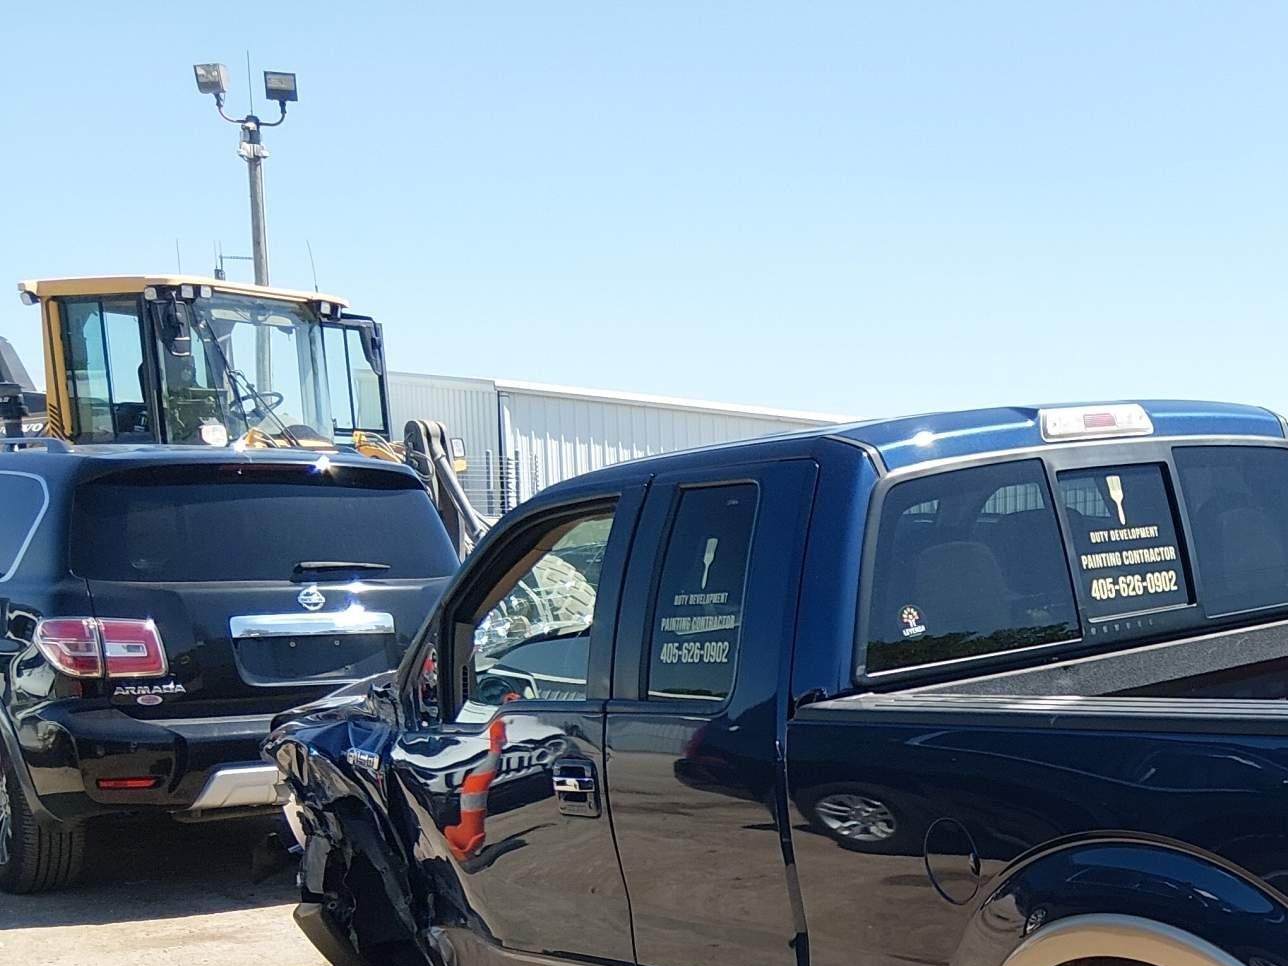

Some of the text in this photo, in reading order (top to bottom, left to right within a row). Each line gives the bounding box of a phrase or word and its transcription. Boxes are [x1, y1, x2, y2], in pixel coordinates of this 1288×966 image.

[1090, 526, 1158, 543] DUTY DEVELOPMENT
[1081, 546, 1176, 570] PAINTING CONTRACTOR
[1091, 570, 1178, 600] 405-626-0902
[688, 592, 729, 605] DEVELOPMENT
[661, 615, 735, 632] PAINTING CONTRACTOR
[660, 641, 729, 663] 405-626-0902
[113, 683, 187, 696] ARMADA
